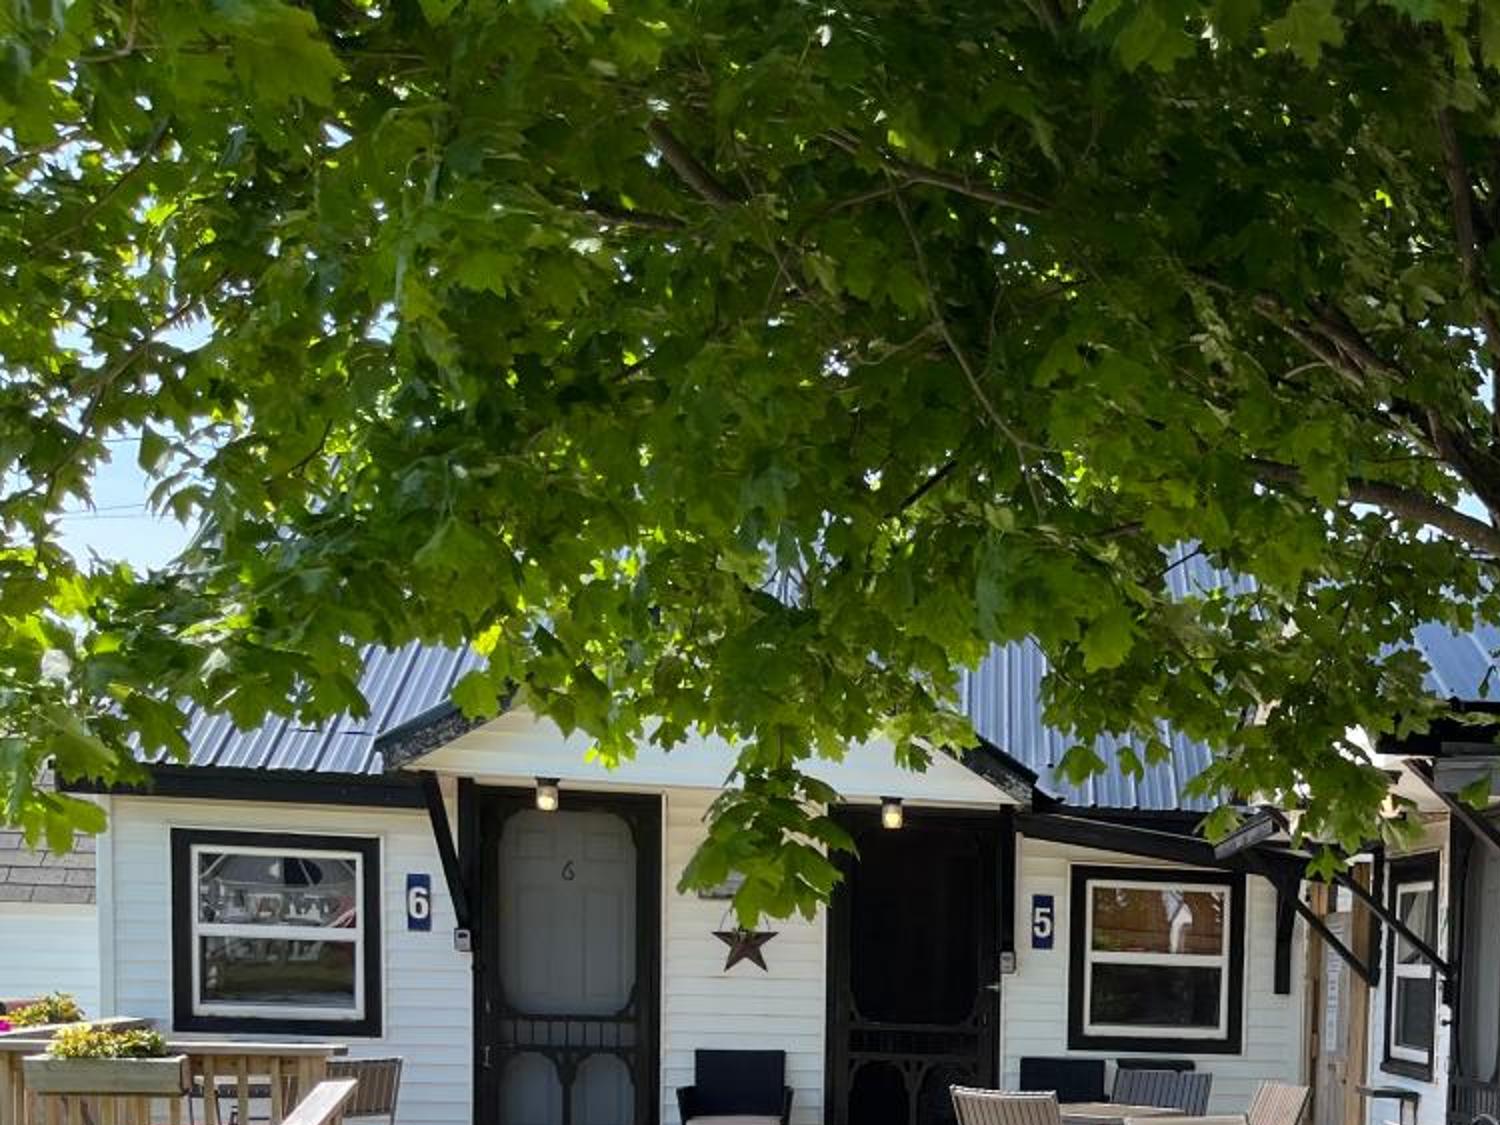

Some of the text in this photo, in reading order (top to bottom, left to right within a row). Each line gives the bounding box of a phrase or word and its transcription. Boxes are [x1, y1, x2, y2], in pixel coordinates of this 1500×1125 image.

[561, 860, 575, 881] 6
[408, 887, 429, 919] 6
[1033, 907, 1051, 938] 5
